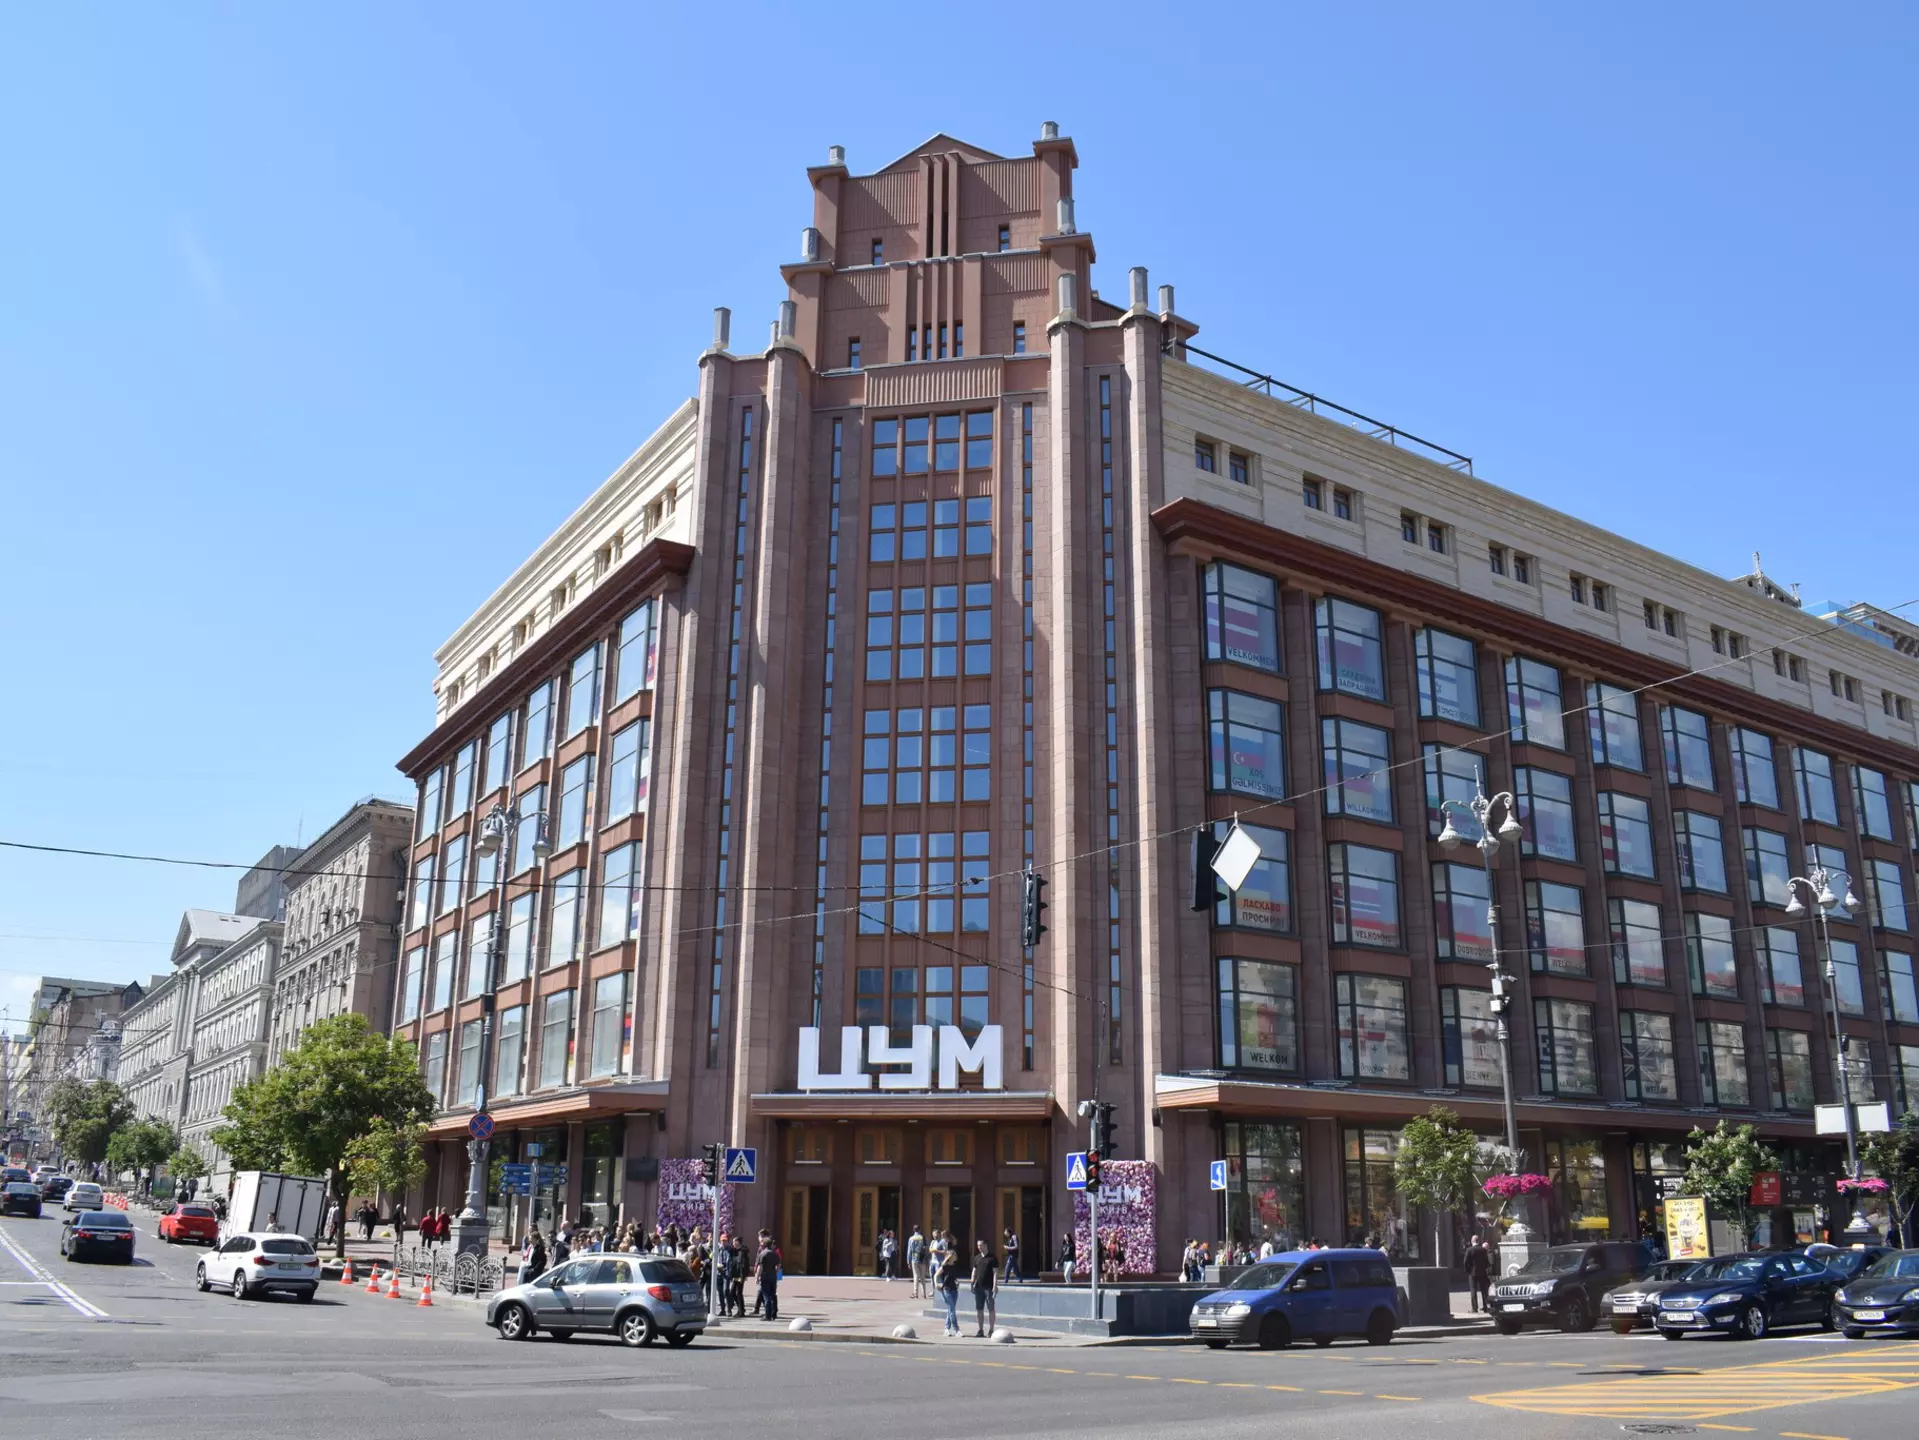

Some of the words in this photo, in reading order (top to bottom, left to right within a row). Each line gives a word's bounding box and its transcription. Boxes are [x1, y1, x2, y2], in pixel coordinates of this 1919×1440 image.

[1242, 898, 1281, 912] ЛАСКАВО
[798, 1024, 1003, 1089] ЦУМ
[1250, 1051, 1288, 1065] WELKOM
[669, 1183, 717, 1200] ЦУМ
[1086, 1184, 1142, 1203] ЦУМ
